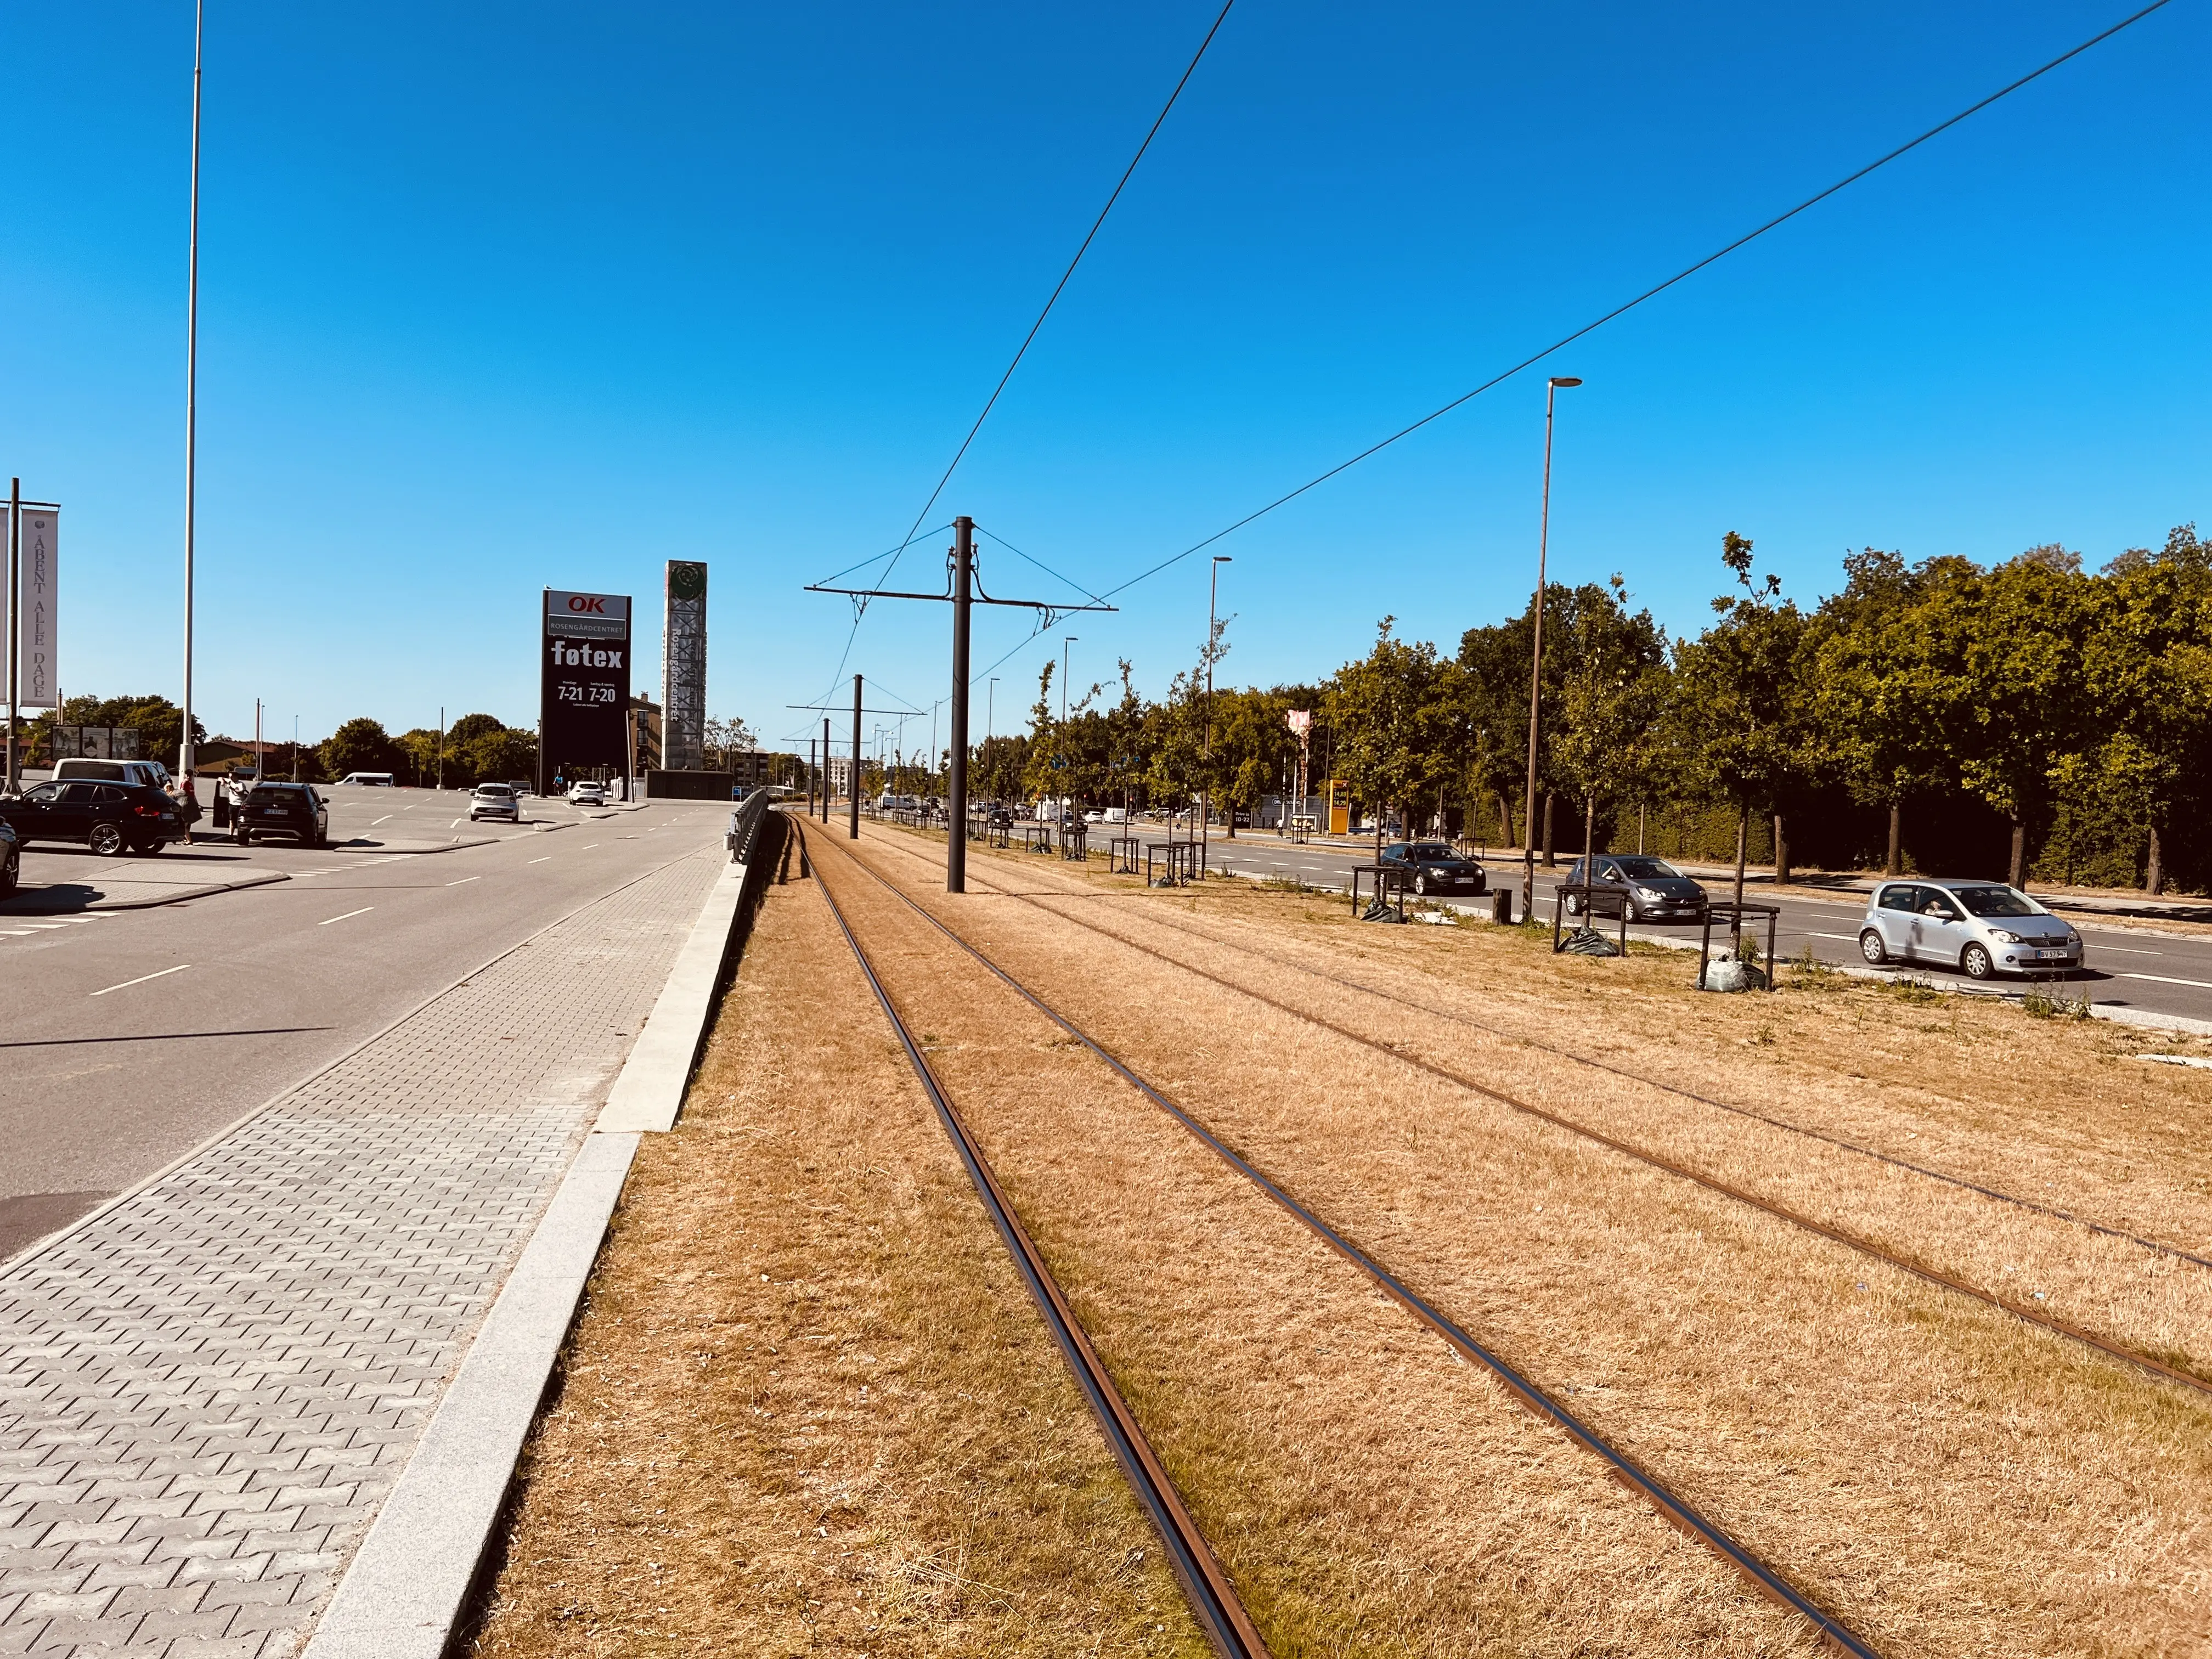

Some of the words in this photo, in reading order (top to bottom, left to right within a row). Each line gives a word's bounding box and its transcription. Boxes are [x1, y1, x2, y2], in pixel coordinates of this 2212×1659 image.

[34, 534, 45, 594] ÅBENT
[34, 601, 45, 645] ALLE
[568, 596, 606, 614] OK
[550, 623, 623, 633] ROSENGÅRDCENTRET
[551, 640, 623, 669] føtex
[33, 652, 45, 697] DAGE
[669, 628, 681, 721] Rosengårdcentret
[558, 686, 582, 701] 7-21
[589, 688, 616, 702] 7-20
